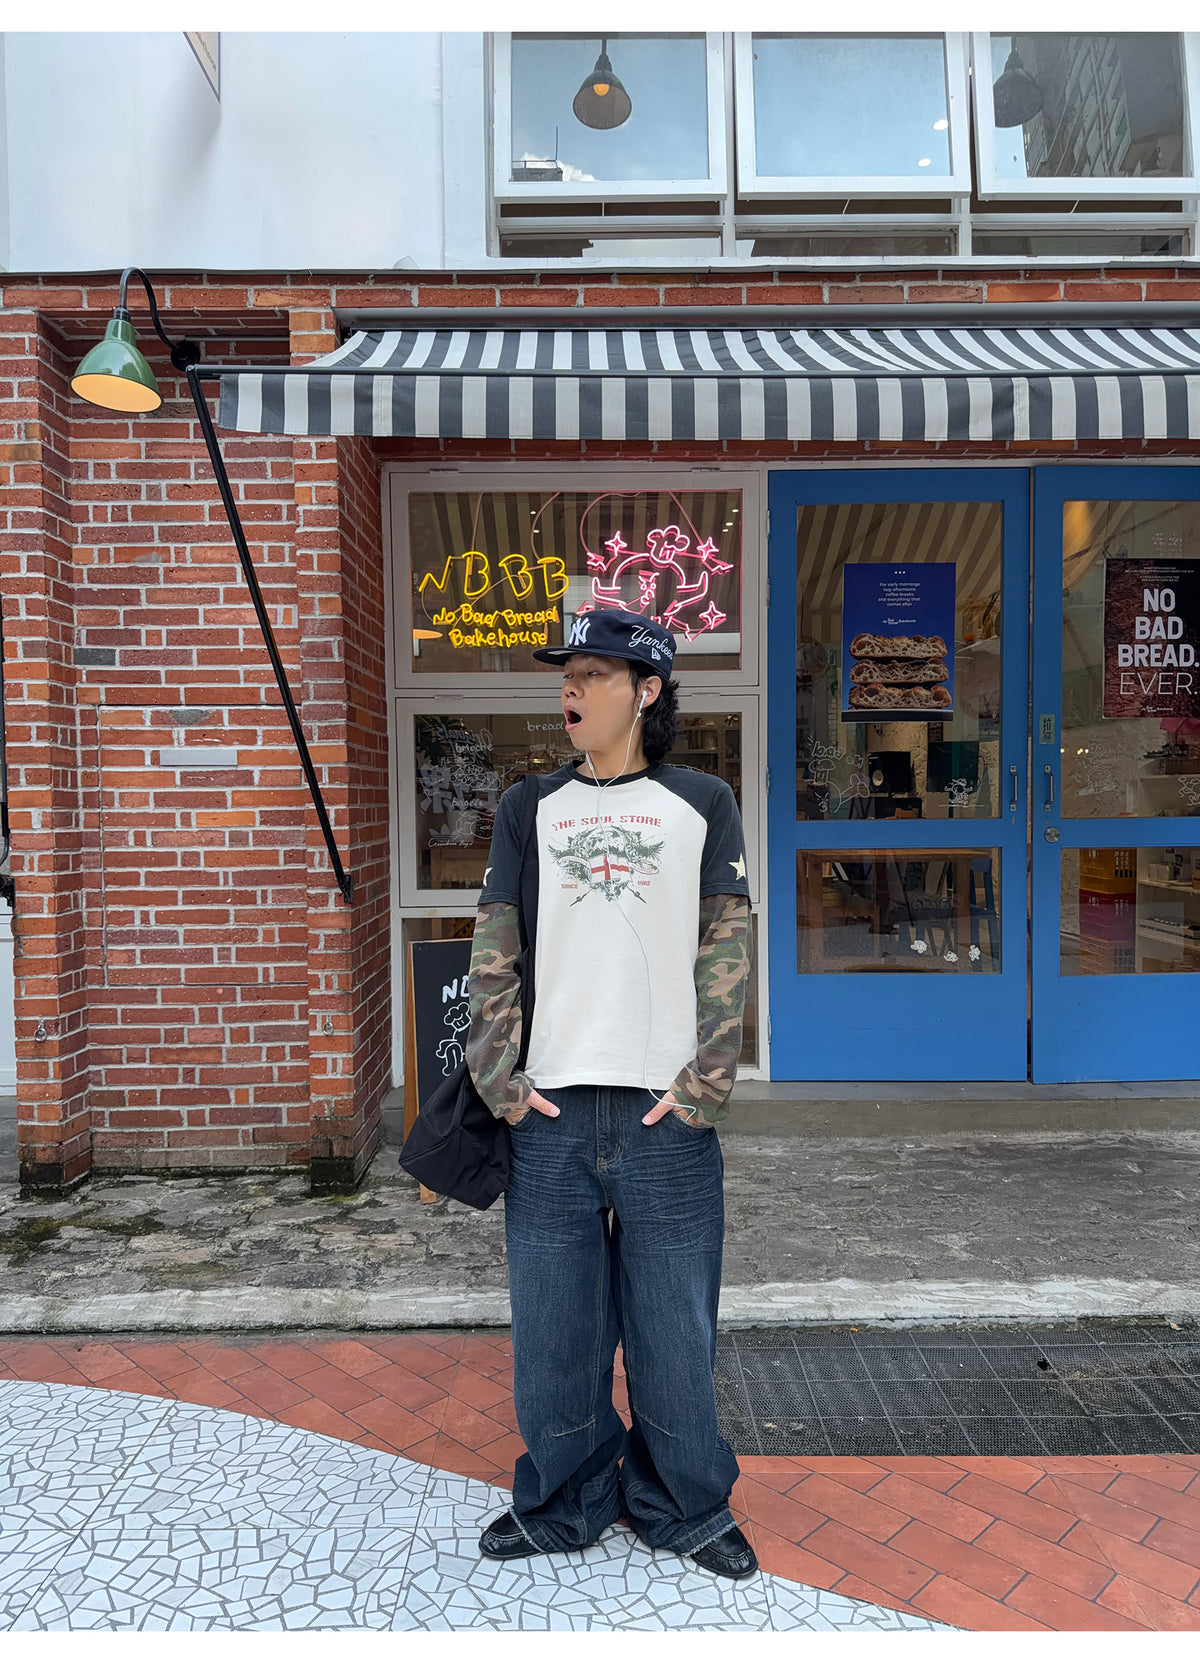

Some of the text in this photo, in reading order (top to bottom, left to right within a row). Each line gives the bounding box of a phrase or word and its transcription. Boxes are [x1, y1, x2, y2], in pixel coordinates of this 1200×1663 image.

[1143, 588, 1176, 612] NO
[433, 603, 559, 628] No Bad Bread
[449, 628, 548, 648] Bakehouse
[568, 617, 591, 646] NY
[1135, 616, 1184, 640] BAD
[1117, 644, 1200, 667] BREAD.
[1120, 672, 1198, 695] EVER.
[551, 819, 576, 831] THE
[620, 815, 662, 828] STORE
